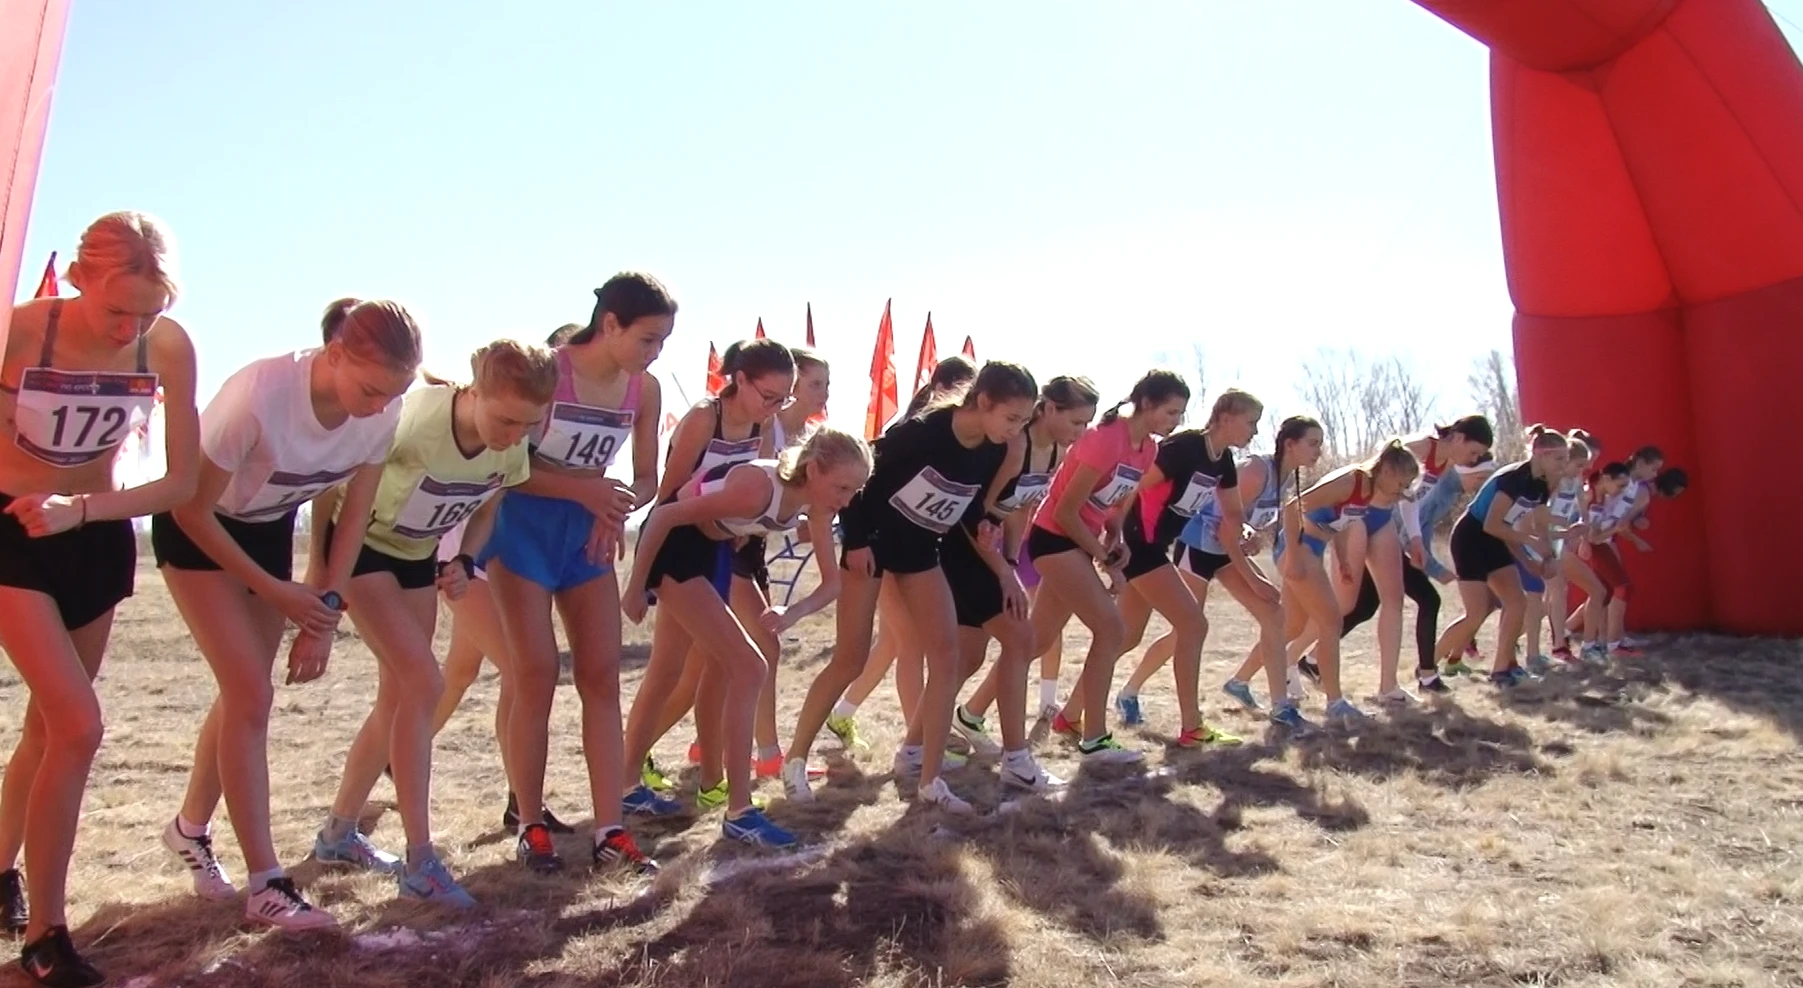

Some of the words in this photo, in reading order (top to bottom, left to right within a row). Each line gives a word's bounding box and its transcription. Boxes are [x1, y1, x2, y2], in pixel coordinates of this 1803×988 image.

[53, 406, 126, 447] 172
[565, 431, 616, 467] 149
[915, 492, 959, 521] 145
